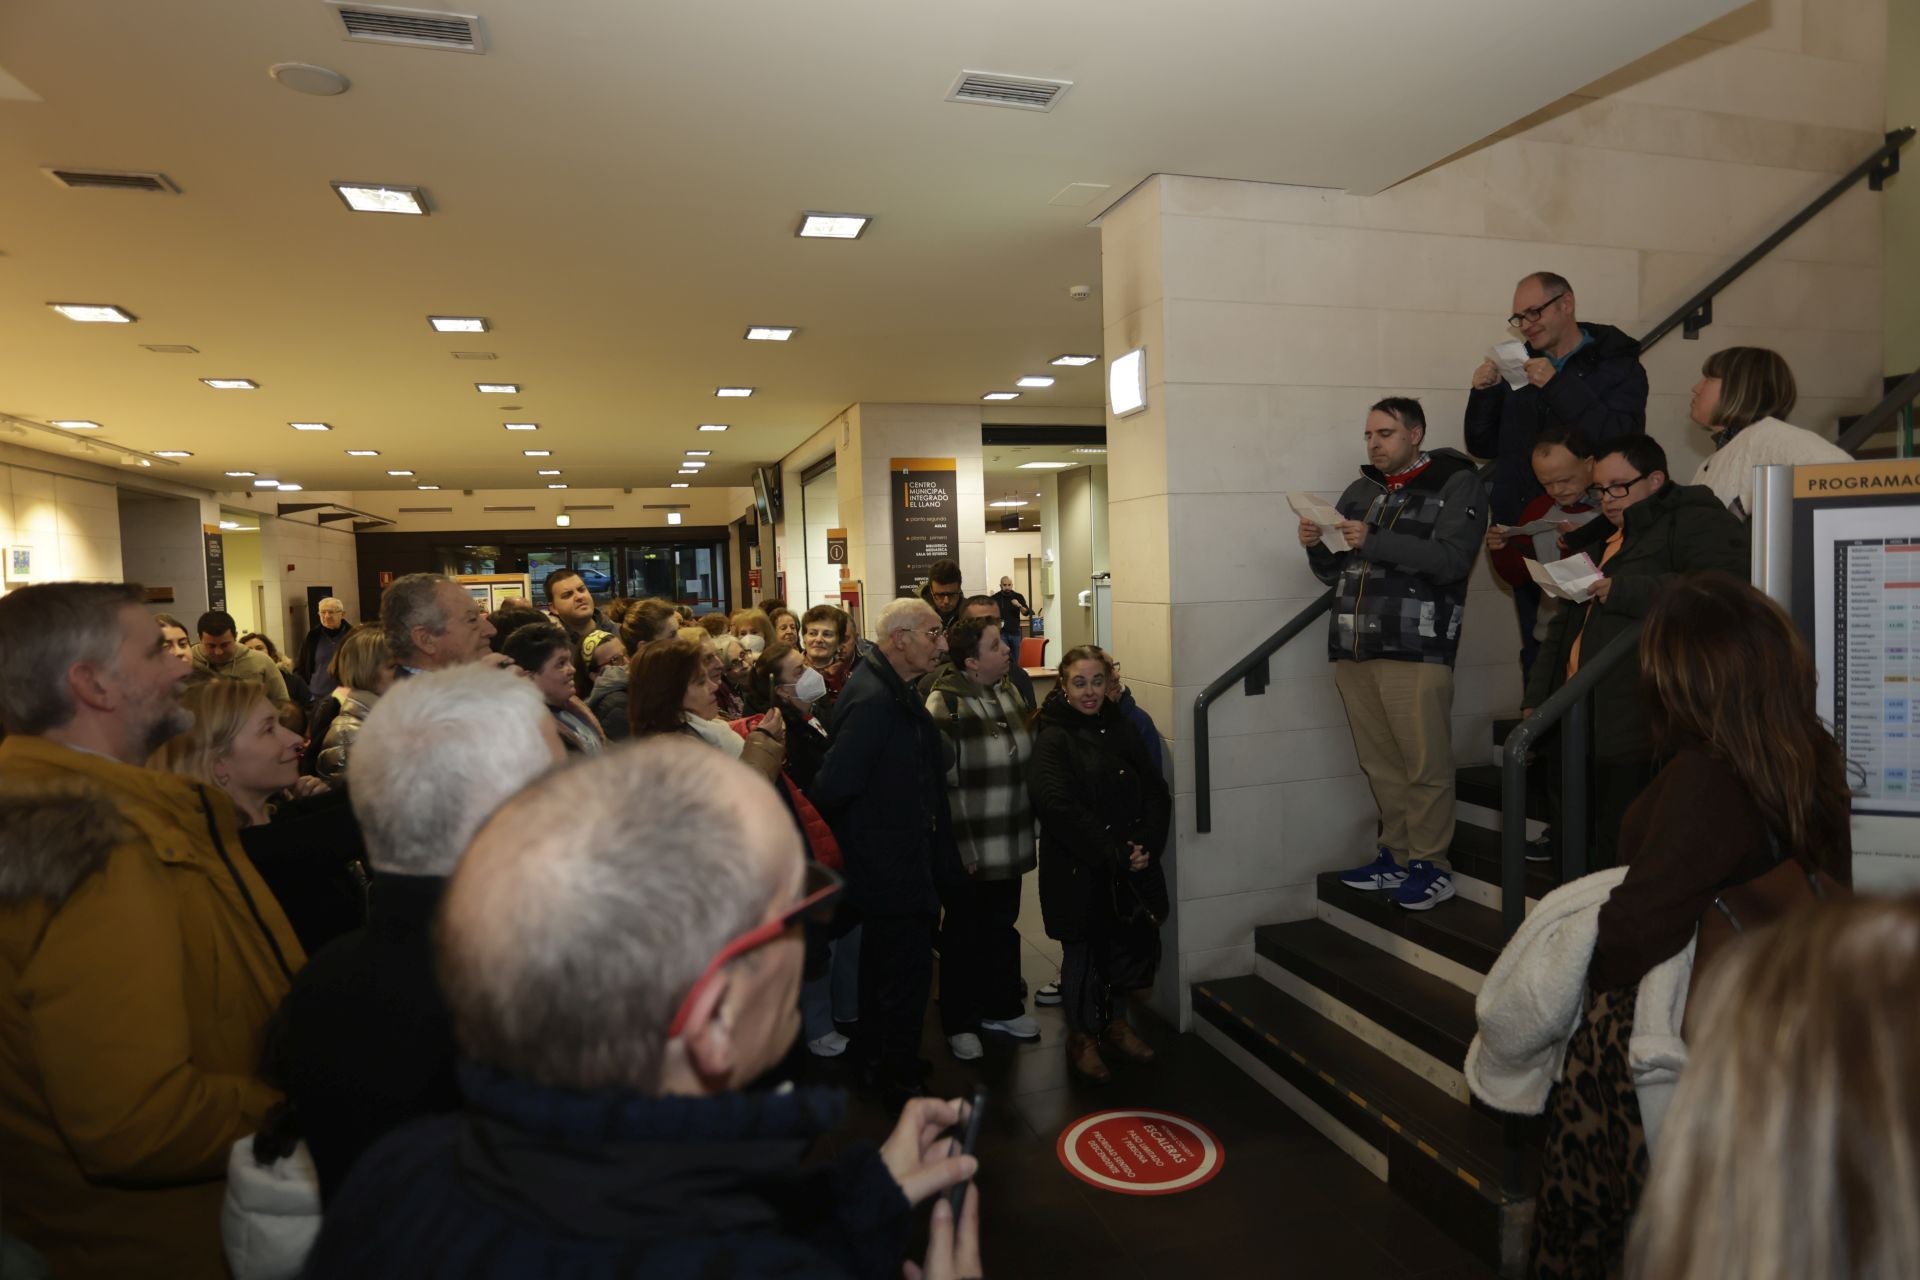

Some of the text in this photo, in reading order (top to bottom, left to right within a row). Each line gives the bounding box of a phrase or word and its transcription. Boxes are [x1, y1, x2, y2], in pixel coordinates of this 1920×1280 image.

[1087, 1140, 1121, 1173] DESCENDENTE
[1091, 1131, 1137, 1178] PRIORIDAD SENTIDO
[1123, 1140, 1148, 1164] PERSONA
[1126, 1130, 1165, 1166] PASO LIMITADO
[1143, 1124, 1187, 1163] ESCALERAS
